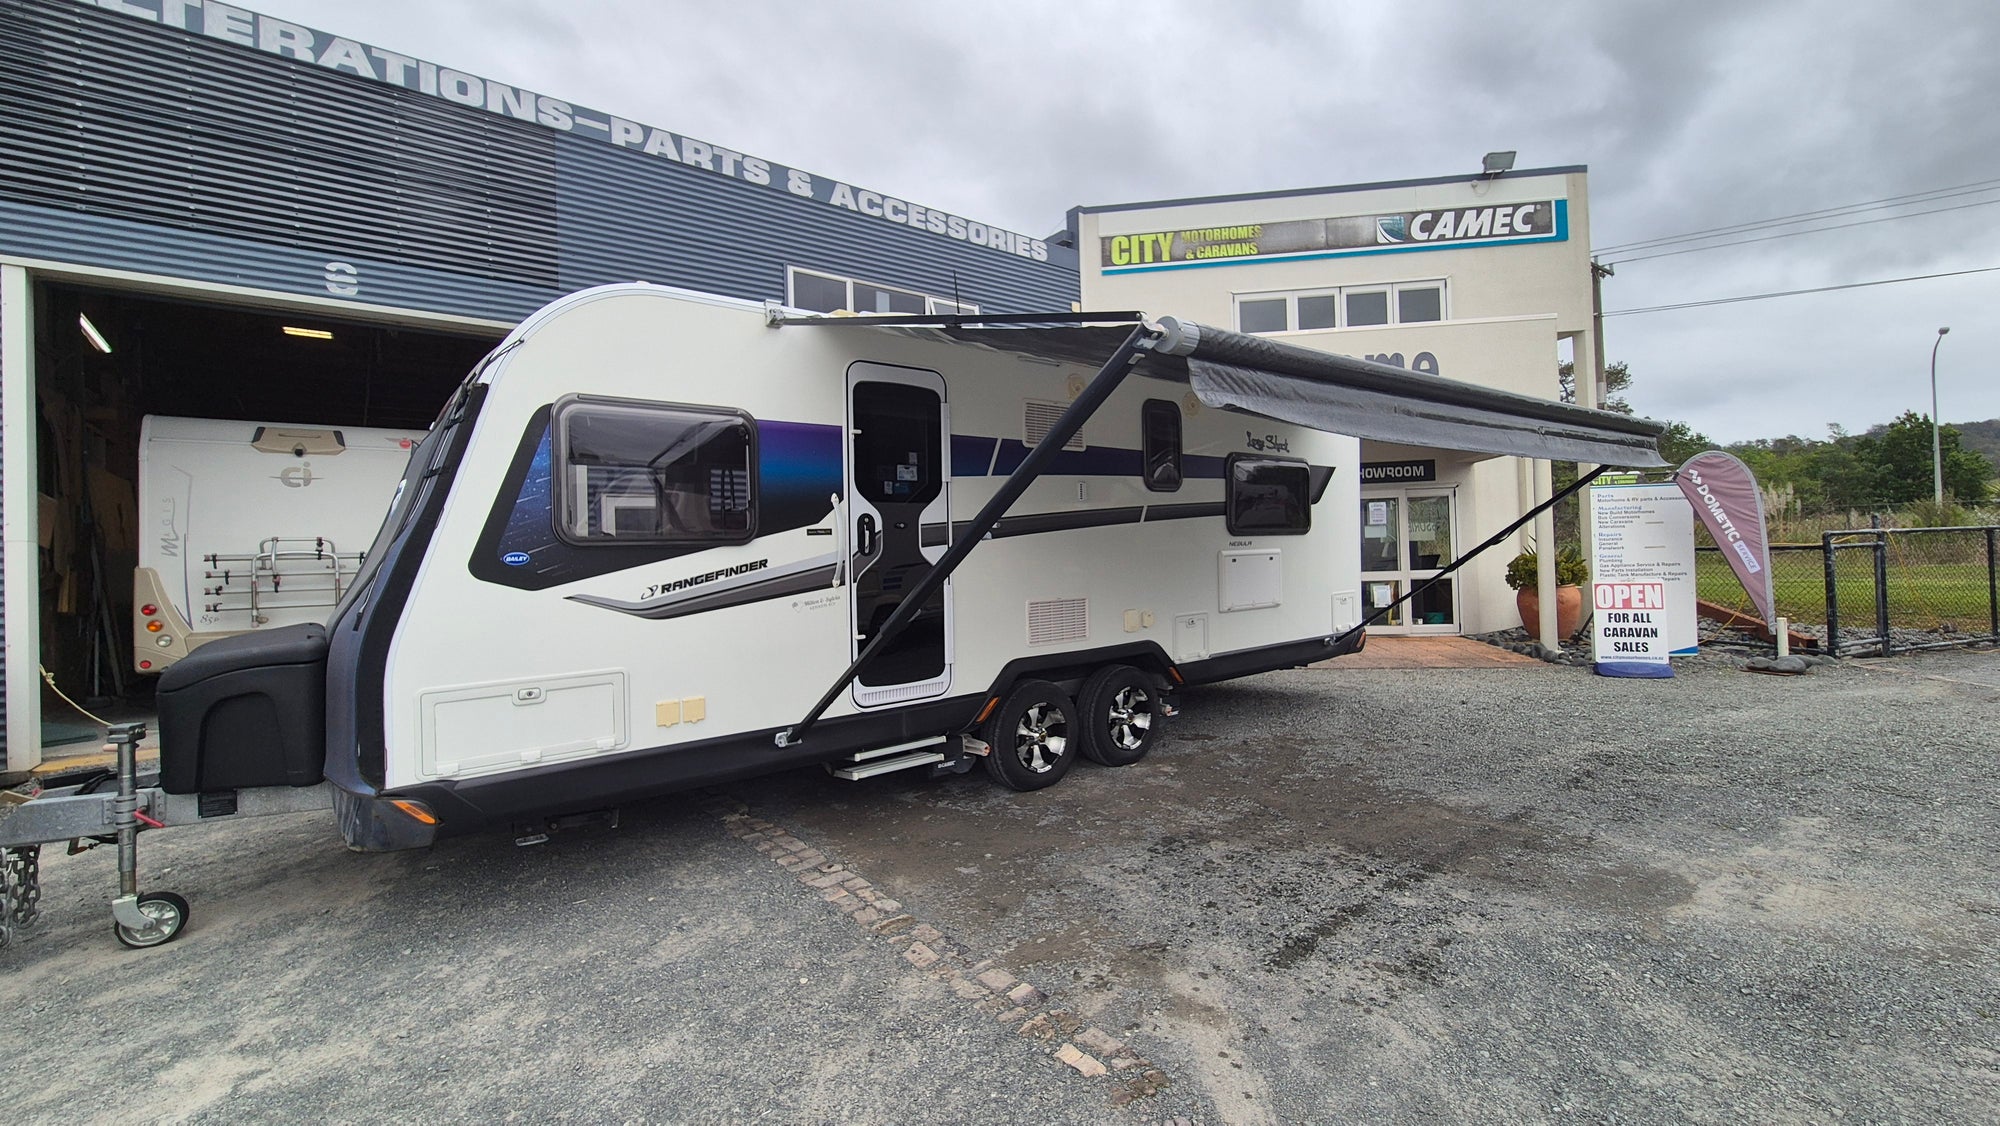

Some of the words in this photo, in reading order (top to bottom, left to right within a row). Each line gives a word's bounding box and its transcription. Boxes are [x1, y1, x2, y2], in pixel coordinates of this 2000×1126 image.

[787, 168, 814, 198] &
[829, 182, 1048, 262] ACCESSORIES
[1410, 204, 1535, 241] CAMEC
[1180, 224, 1263, 243] MOTORHOMES
[1111, 232, 1175, 265] CITY
[1185, 249, 1194, 260] &
[1196, 242, 1258, 259] CARAVANS
[1697, 484, 1740, 542] DOMETIC
[660, 558, 769, 594] RANGEFINDER
[1596, 584, 1662, 608] OPEN
[1608, 612, 1629, 623] FOR
[1632, 612, 1652, 623] ALL
[1603, 627, 1658, 638] CARAVAN
[1614, 641, 1649, 653] SALES
